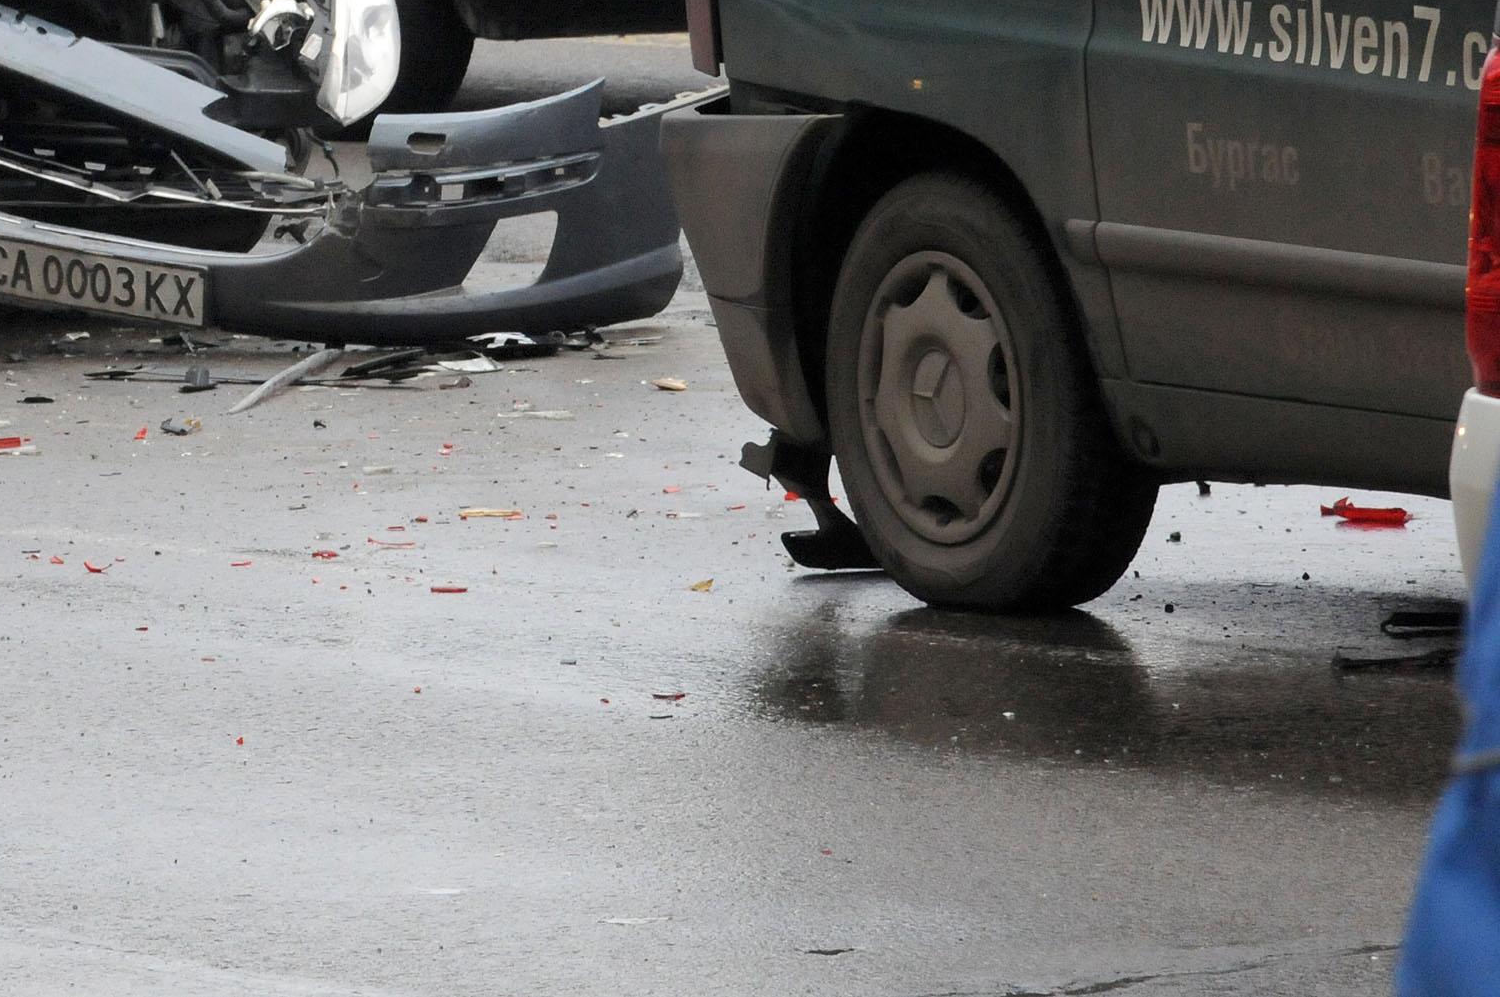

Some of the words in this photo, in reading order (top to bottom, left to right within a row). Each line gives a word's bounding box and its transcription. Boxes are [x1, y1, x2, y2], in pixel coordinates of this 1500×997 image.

[1186, 122, 1300, 191] Бургас
[1422, 153, 1466, 205] Ва
[43, 255, 136, 307] 0003
[145, 270, 196, 318] KX
